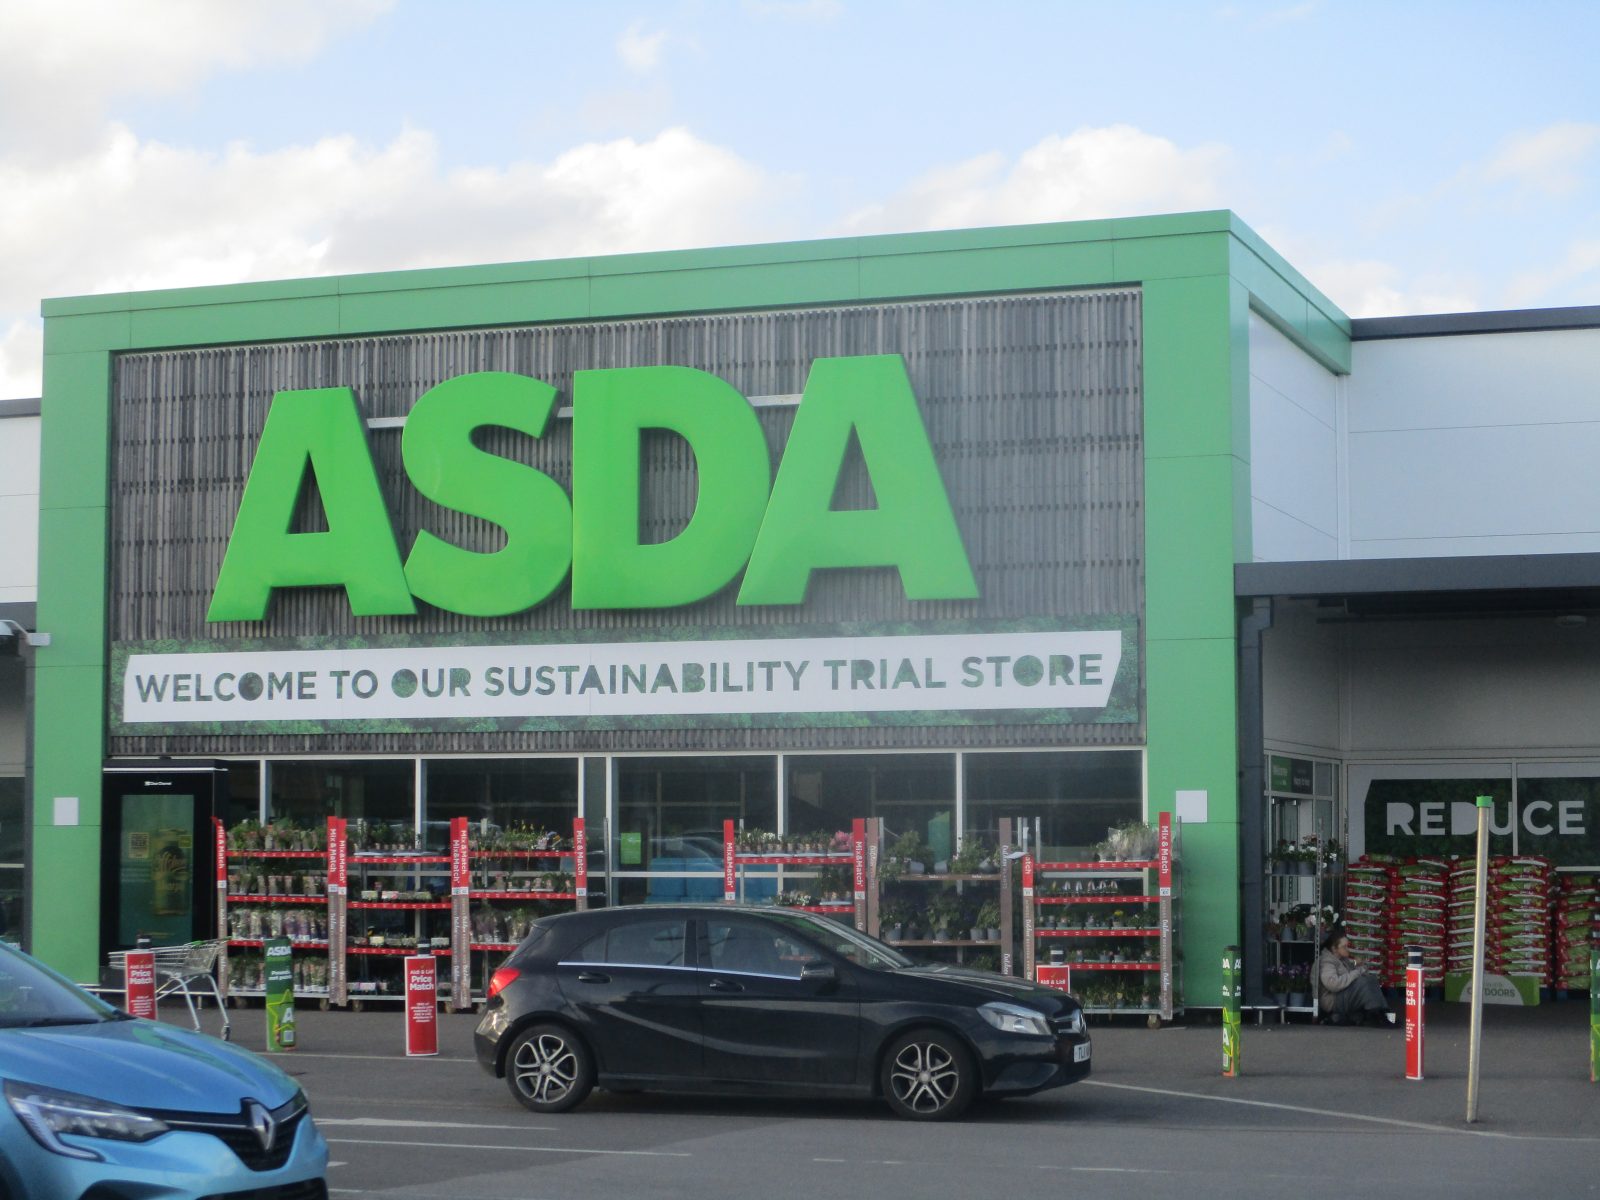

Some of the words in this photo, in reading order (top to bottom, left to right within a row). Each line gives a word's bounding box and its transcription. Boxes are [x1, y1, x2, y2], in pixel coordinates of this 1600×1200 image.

[205, 353, 980, 622] ASDA
[135, 670, 317, 702] WELCOME
[329, 668, 379, 699] TO
[391, 667, 472, 698] OUR
[484, 660, 810, 697] SUSTAINABILITY
[823, 658, 947, 690] TRIAL
[961, 653, 1104, 688] STORE
[1386, 800, 1586, 836] REDUCE
[410, 983, 434, 991] Match
[411, 975, 432, 983] Price
